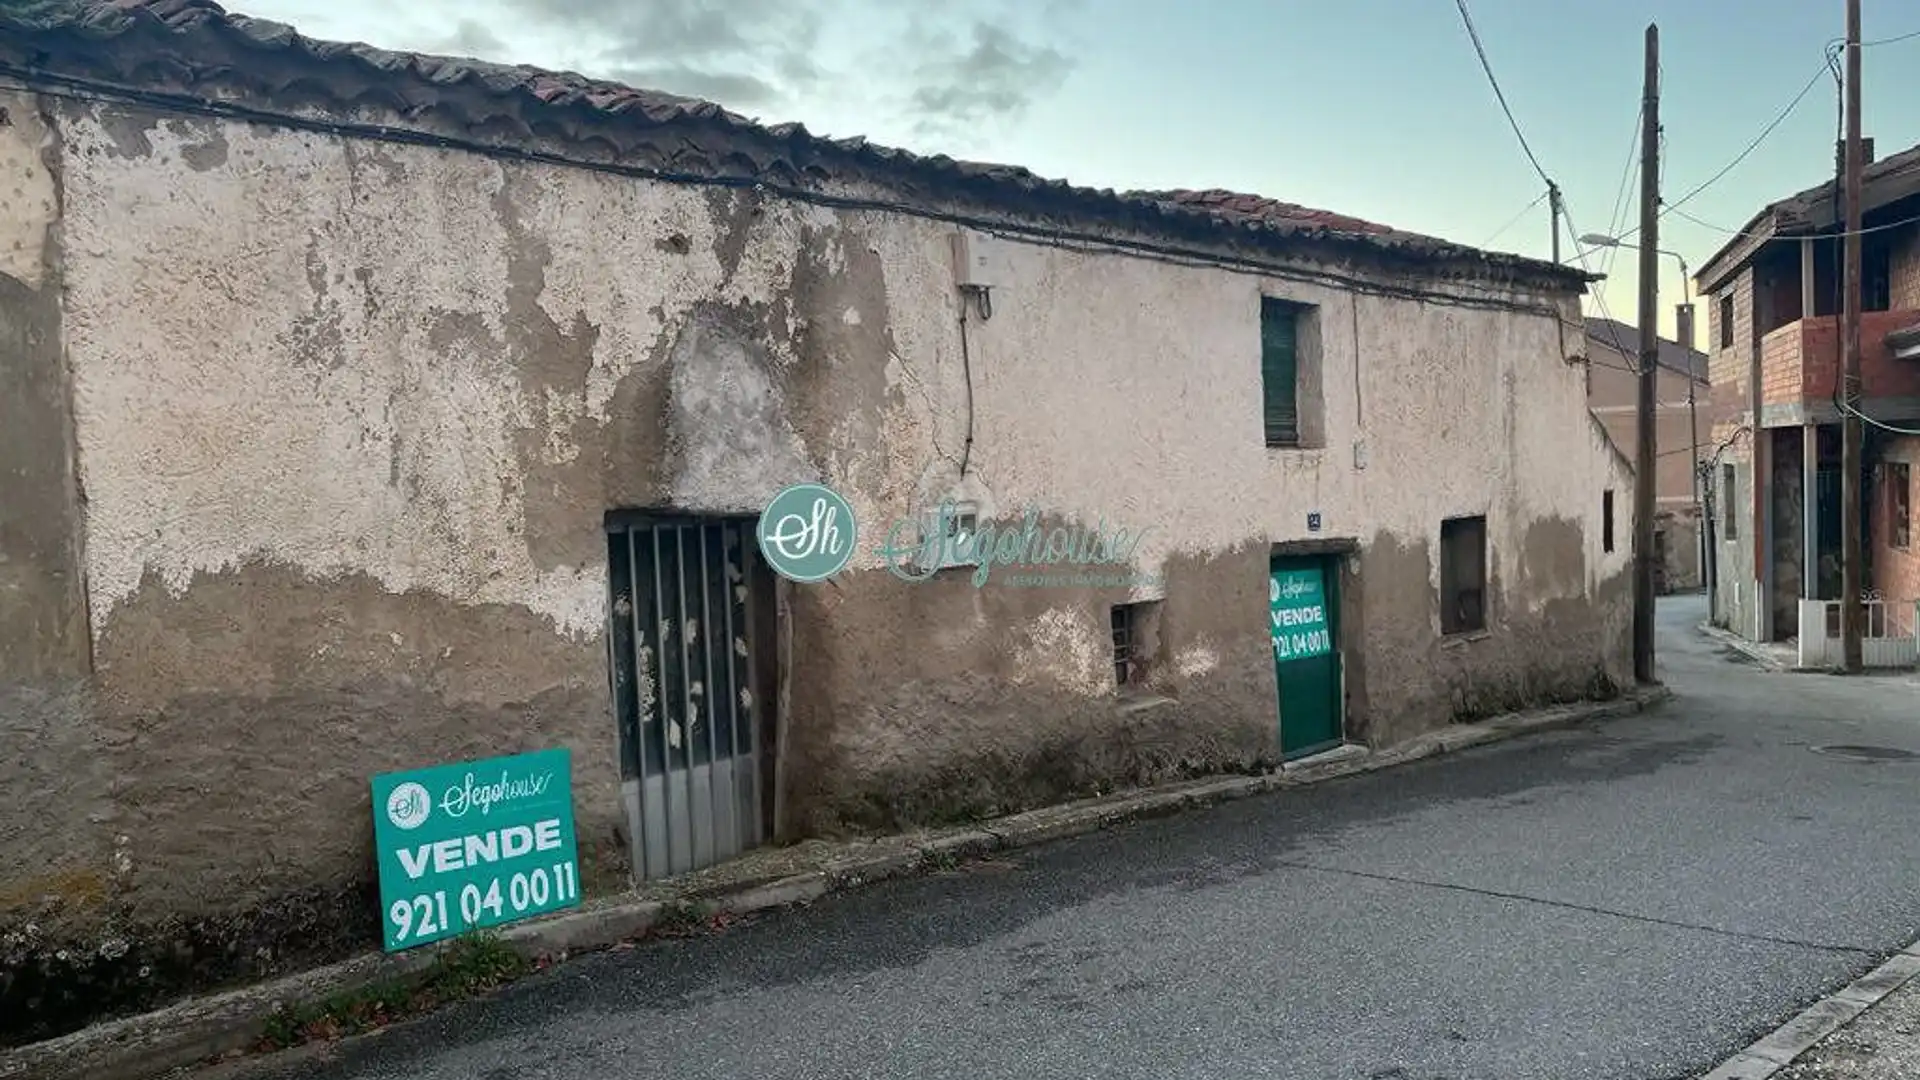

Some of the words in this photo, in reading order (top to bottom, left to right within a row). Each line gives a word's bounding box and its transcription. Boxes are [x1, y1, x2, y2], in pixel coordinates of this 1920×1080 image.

[1271, 606, 1323, 627] VENDE
[437, 770, 553, 817] Segohouse
[396, 818, 562, 879] VENDE
[390, 890, 448, 942] 921
